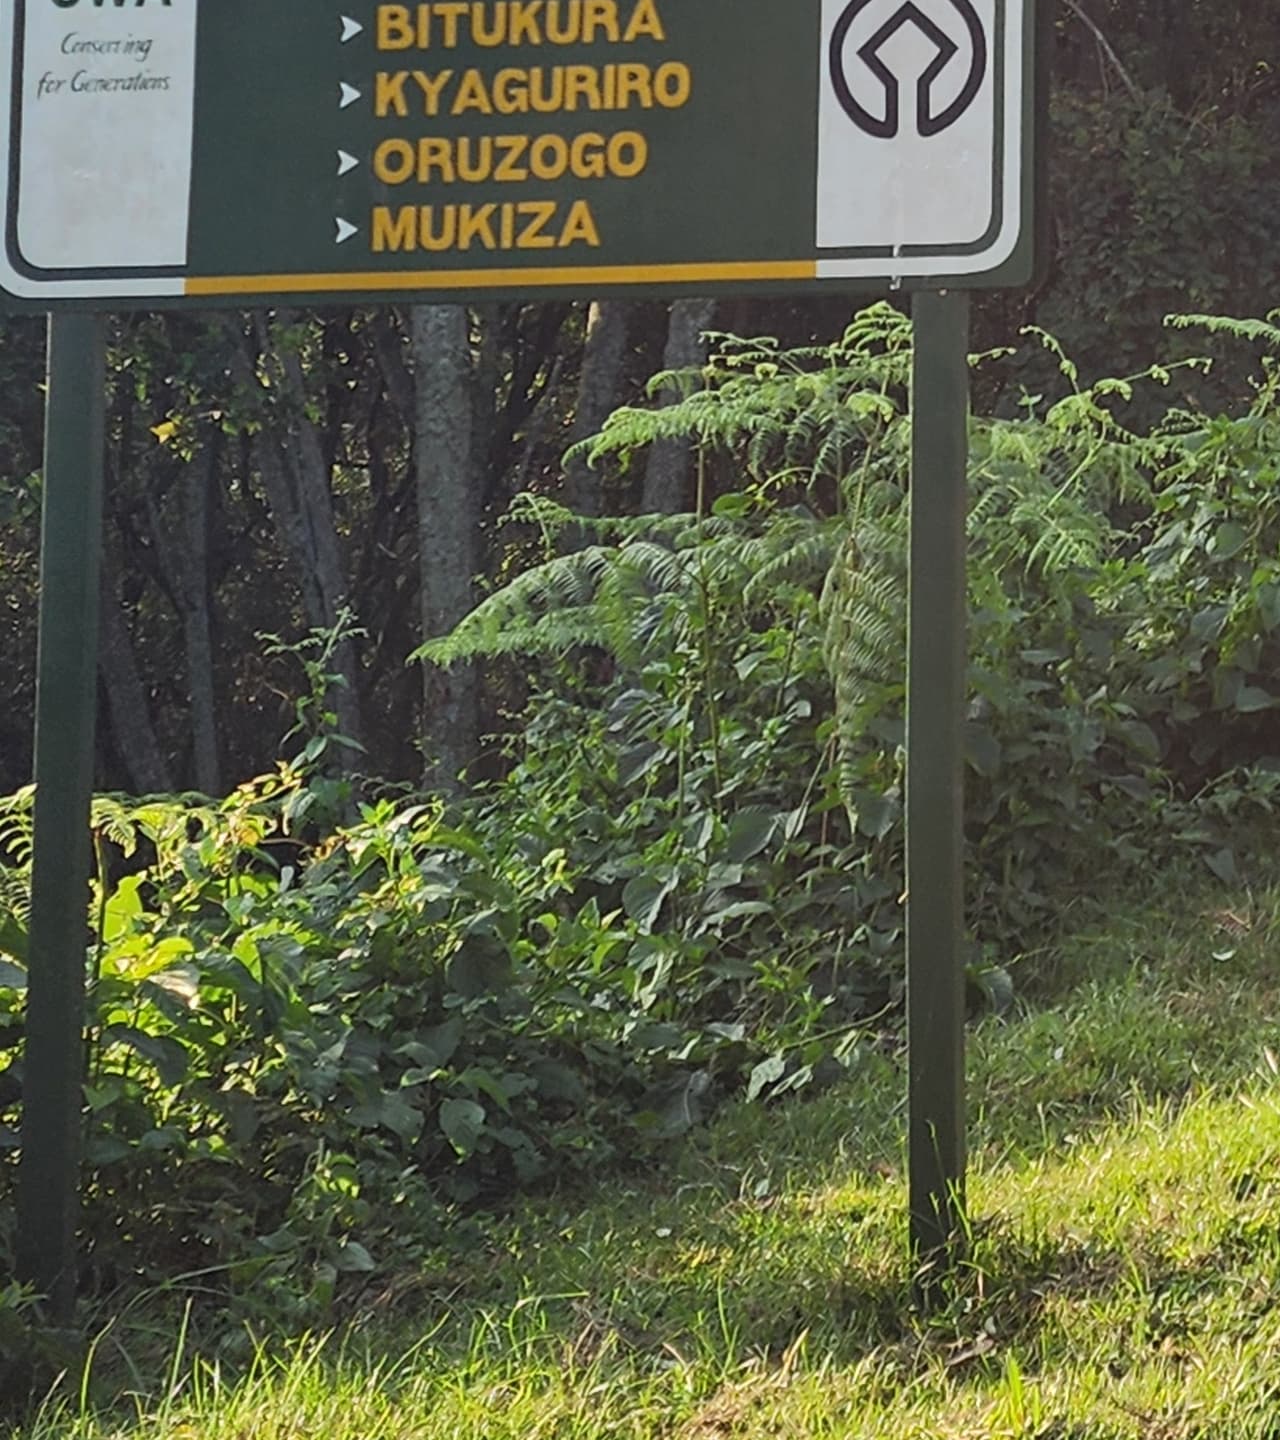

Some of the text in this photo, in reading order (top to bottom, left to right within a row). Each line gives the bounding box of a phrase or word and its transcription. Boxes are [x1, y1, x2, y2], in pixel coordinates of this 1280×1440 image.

[36, 68, 171, 100] for Generations
[375, 61, 691, 117] KYAGURIRO
[374, 131, 648, 184] ORUZOGO
[371, 200, 599, 252] MUKIZA
